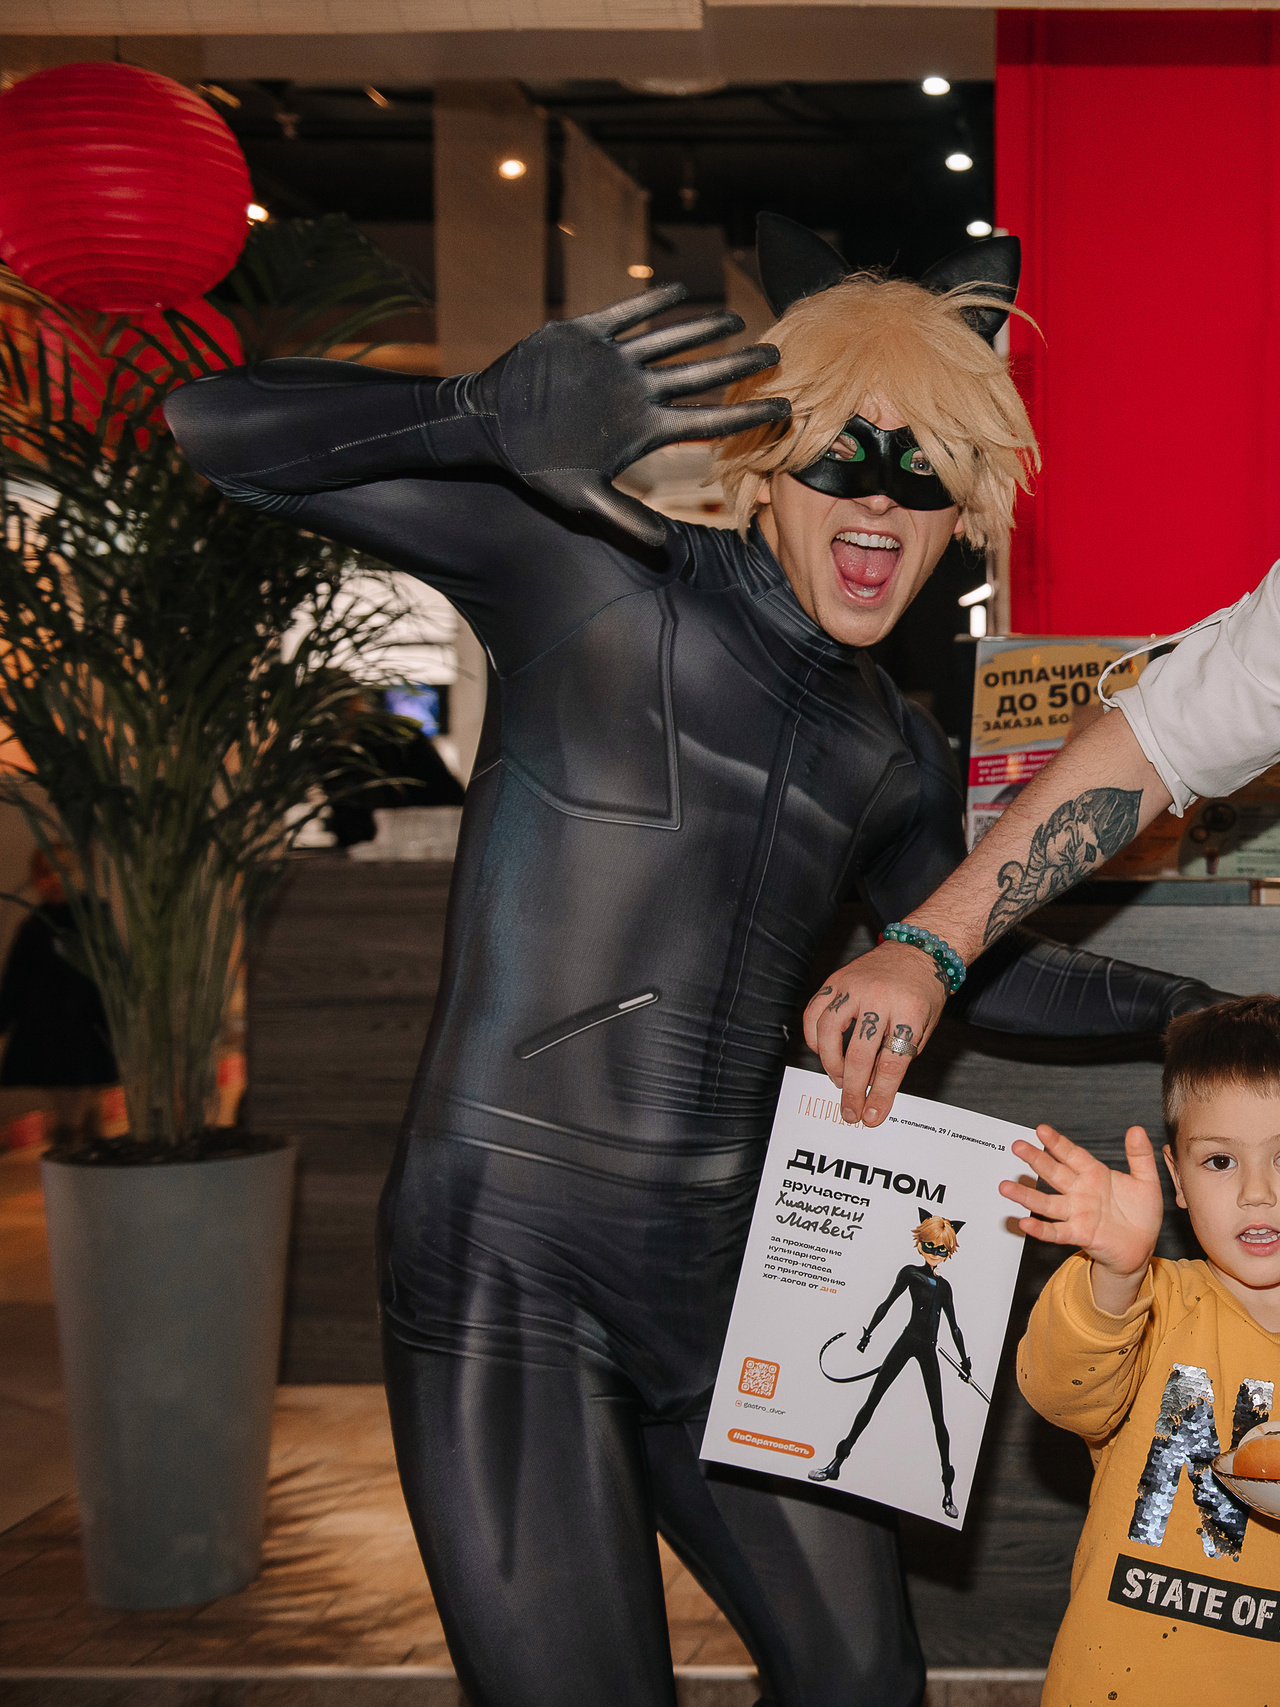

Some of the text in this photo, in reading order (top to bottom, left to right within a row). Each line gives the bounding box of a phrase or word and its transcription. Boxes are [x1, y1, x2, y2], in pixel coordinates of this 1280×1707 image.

[997, 693, 1037, 717] ДО
[983, 716, 1043, 732] ЗАКАЗА
[938, 1127, 947, 1135] 29
[782, 1179, 871, 1207] вручается
[776, 1212, 863, 1241] Матвей
[768, 1244, 827, 1264] кулинарного
[770, 1235, 843, 1258] за прохождение
[764, 1262, 847, 1287] по приготовлению
[766, 1254, 833, 1274] мастер-класса
[762, 1272, 807, 1288] хот-догов
[808, 1282, 819, 1291] от
[1121, 1568, 1228, 1620] STATE
[1231, 1595, 1278, 1630] OF
